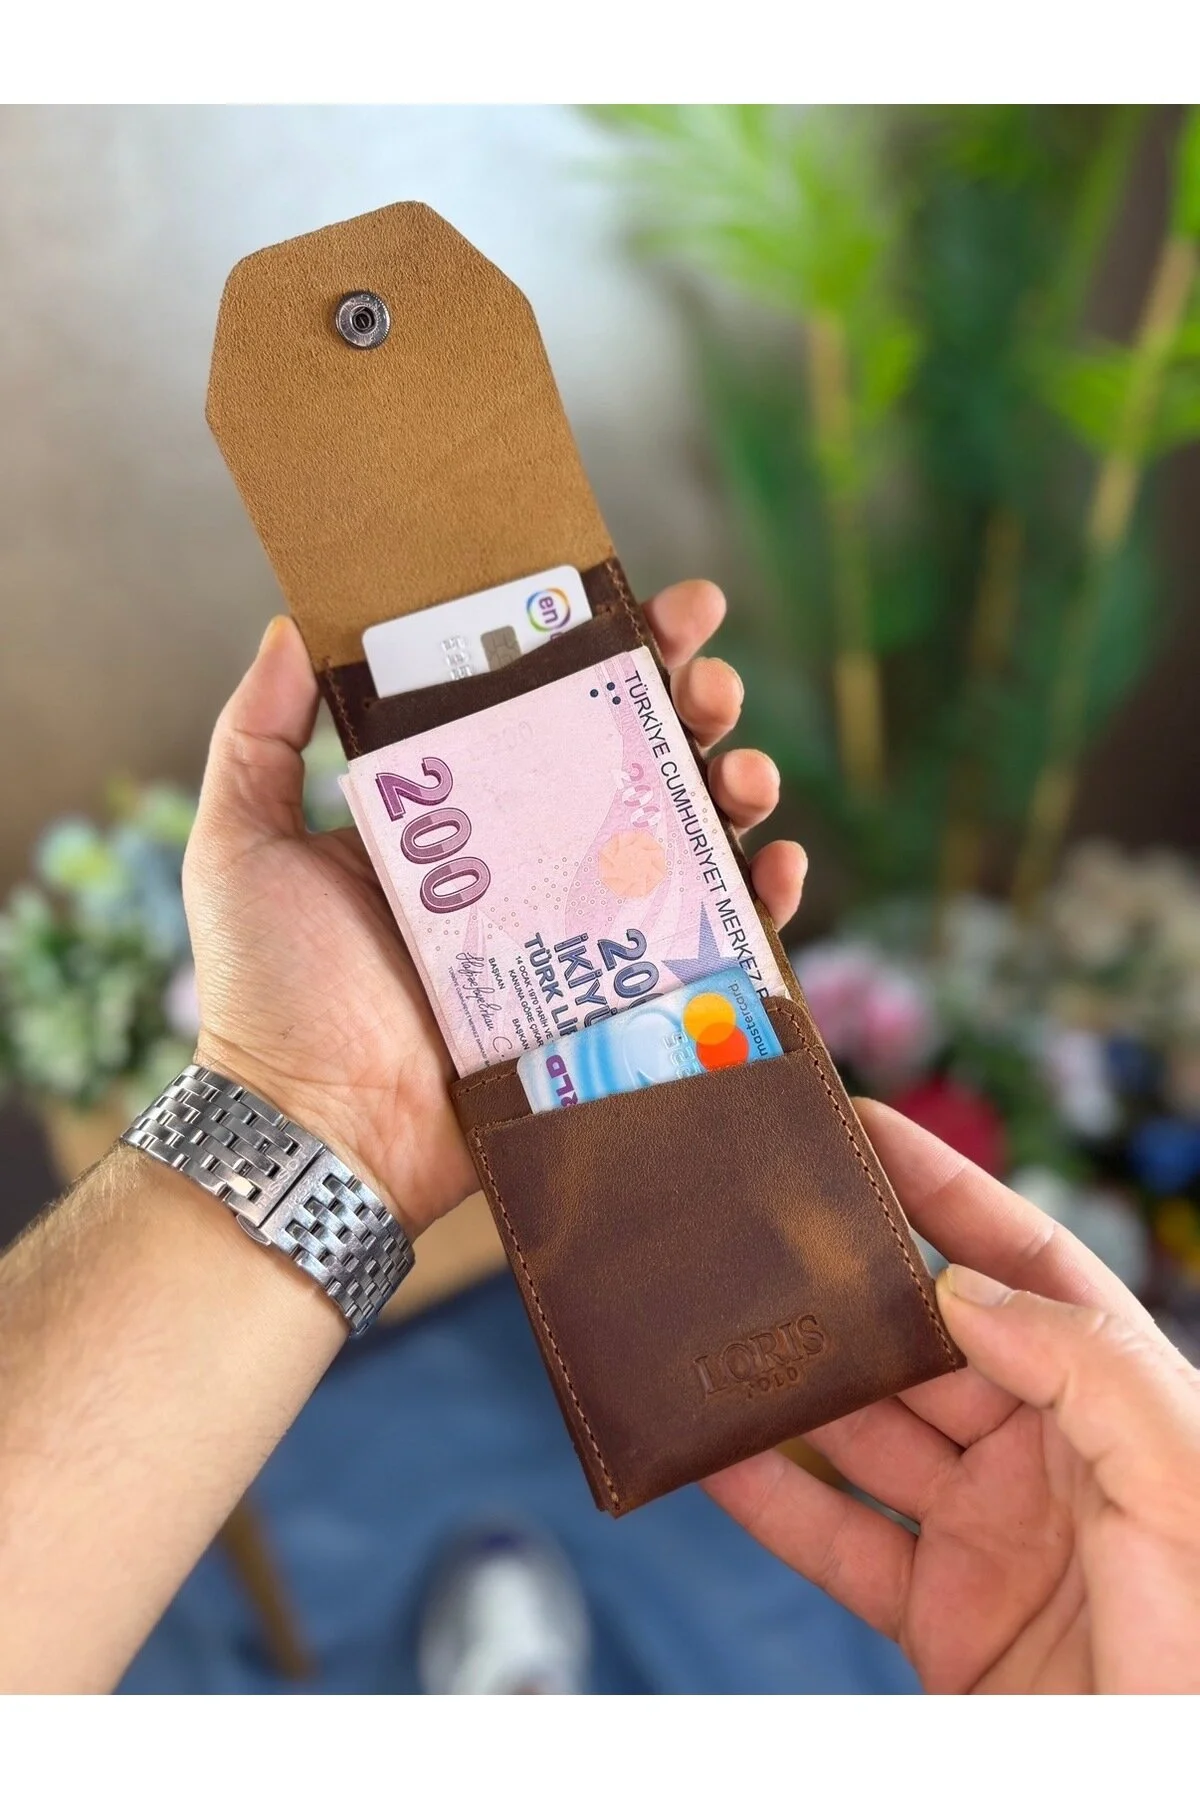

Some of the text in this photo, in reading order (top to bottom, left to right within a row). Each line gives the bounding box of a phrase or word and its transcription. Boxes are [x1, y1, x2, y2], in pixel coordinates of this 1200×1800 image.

[538, 595, 559, 624] en
[618, 761, 661, 828] 200
[624, 669, 671, 758] TÜRKİYE
[660, 761, 727, 893] CUMHURİYET
[375, 756, 491, 914] 200
[487, 956, 506, 990] BAŞKAN
[507, 969, 525, 1001] KANUNA
[520, 1000, 535, 1024] GÖRE
[515, 955, 554, 1041] 14 OCAK 1970 TARİH VE
[524, 931, 564, 1004] TÜRK
[598, 928, 664, 1008] 20
[511, 1017, 531, 1050] BAŞKAN
[694, 1313, 825, 1396] LORIS
[747, 1366, 799, 1400] OLO
